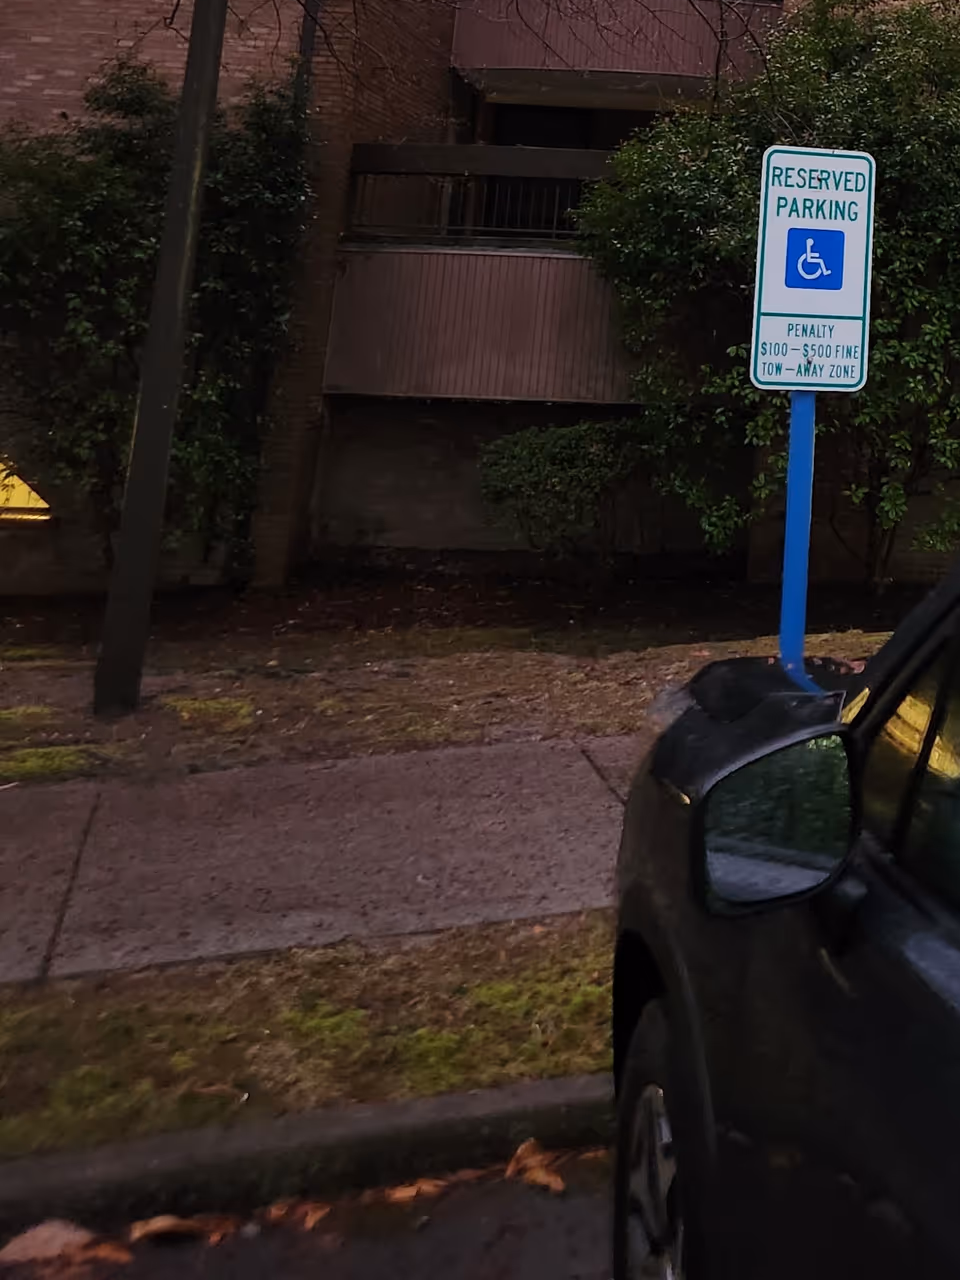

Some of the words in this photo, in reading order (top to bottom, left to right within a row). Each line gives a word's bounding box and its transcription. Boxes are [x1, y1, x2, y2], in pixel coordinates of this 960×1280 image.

[771, 166, 866, 192] RESERVED
[776, 196, 859, 222] PARKING
[787, 323, 835, 338] PENALTY
[835, 345, 859, 359] FINE
[829, 365, 856, 379] ZONE
